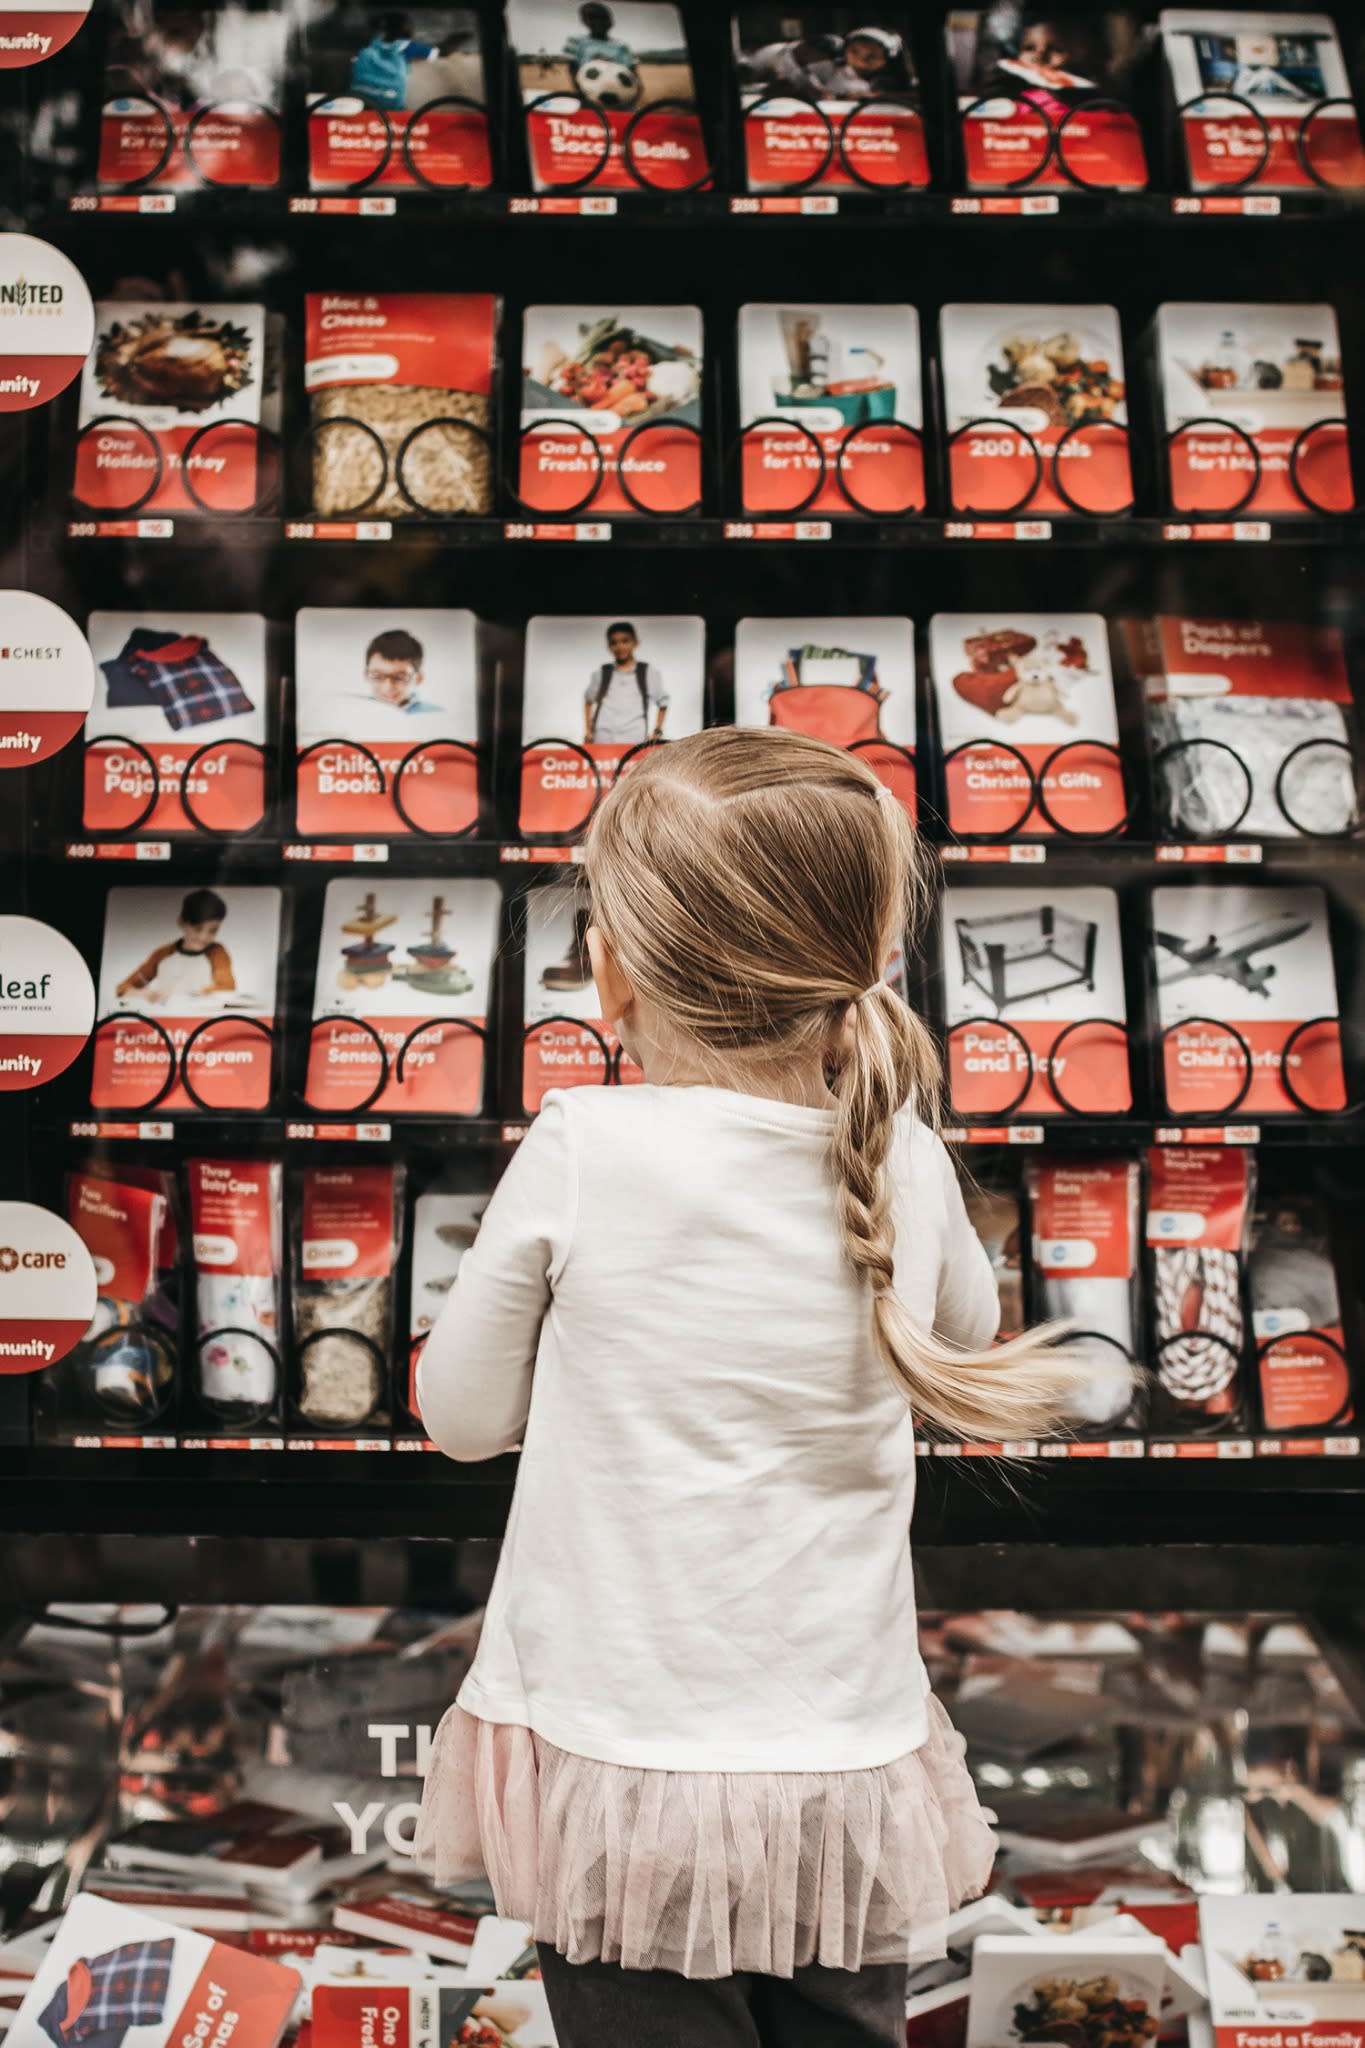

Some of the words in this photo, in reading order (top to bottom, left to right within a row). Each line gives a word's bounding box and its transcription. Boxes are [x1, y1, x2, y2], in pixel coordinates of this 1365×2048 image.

[764, 121, 896, 137] Empowment
[982, 122, 1091, 139] Theraptic
[632, 140, 691, 161] Balls
[765, 136, 809, 150] Pack
[812, 136, 833, 151] fo
[983, 136, 1030, 151] Food
[320, 314, 388, 330] Cheese
[96, 436, 135, 451] One
[538, 440, 577, 455] One
[762, 437, 808, 453] Feed
[969, 439, 1015, 457] 200
[96, 453, 159, 469] Holida
[538, 457, 588, 472] Fresh
[763, 455, 791, 469] for
[104, 755, 153, 774] One
[202, 755, 229, 775] of
[317, 755, 436, 775] Children's
[541, 757, 578, 772] One
[964, 757, 1018, 772] Foster
[104, 774, 209, 799] Pajamas
[541, 774, 588, 789] Child
[1058, 772, 1103, 789] Gifts
[115, 1030, 159, 1045] Fund
[162, 1030, 214, 1046] Aftr-
[540, 1032, 578, 1047] One
[964, 1034, 1019, 1053] Pack
[0, 1054, 42, 1076] unity
[113, 1049, 174, 1065] Schoo
[328, 1050, 395, 1066] Sensoy
[405, 1051, 436, 1067] oys
[540, 1050, 586, 1065] Work
[588, 1051, 634, 1065] Bots
[1177, 1051, 1236, 1067] Child's
[964, 1053, 1011, 1073] and
[1015, 1053, 1067, 1078] Play
[200, 1163, 231, 1179] Three
[228, 1179, 259, 1194] Caps
[21, 1252, 66, 1270] care
[1267, 1355, 1325, 1370] Blankets
[266, 1932, 315, 1946] First
[206, 1981, 228, 2011] of
[360, 2006, 379, 2048] Fres
[382, 2006, 400, 2045] One
[1235, 2032, 1283, 2048] Feed
[1285, 2036, 1300, 2048] a
[1301, 2032, 1363, 2048] Family
